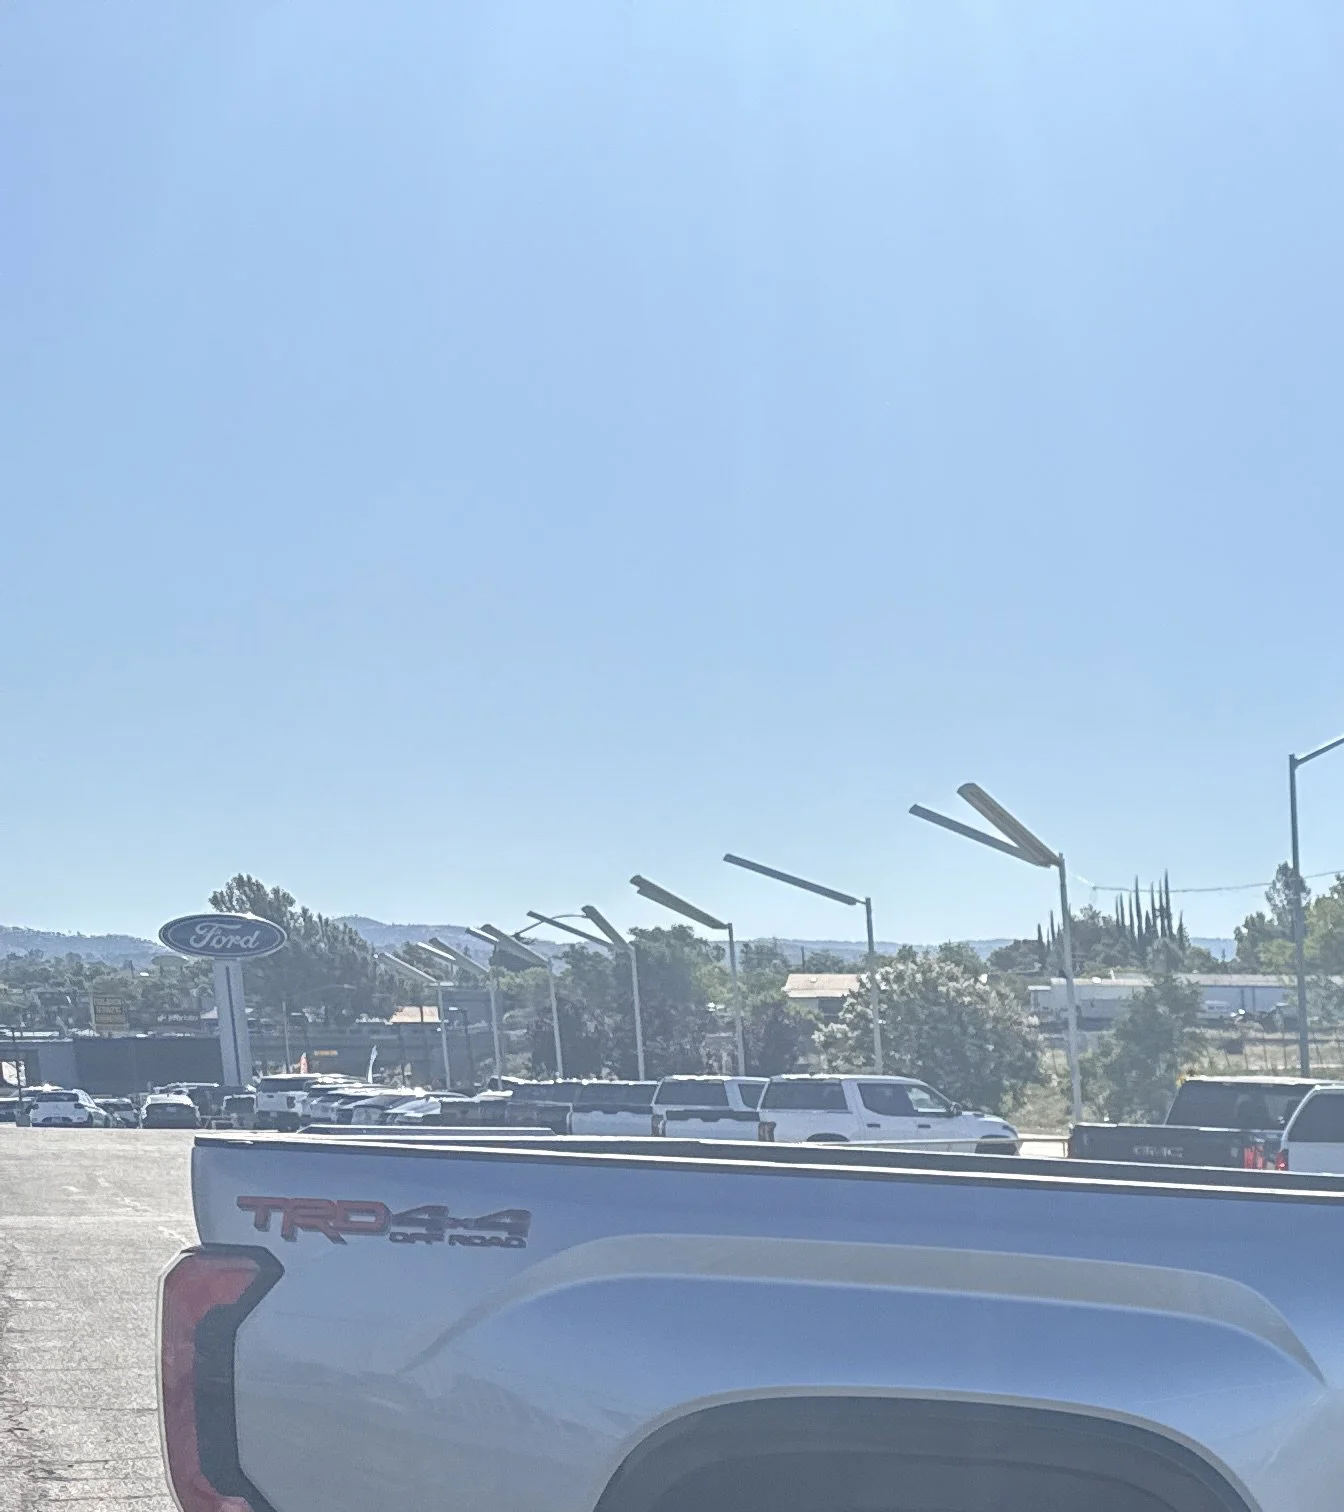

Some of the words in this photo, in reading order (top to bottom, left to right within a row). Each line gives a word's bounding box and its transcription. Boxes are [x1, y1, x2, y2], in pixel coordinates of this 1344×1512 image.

[189, 922, 260, 949] Ford
[236, 1195, 392, 1246] TRD
[389, 1230, 445, 1246] OFF
[447, 1232, 528, 1249] ROAD
